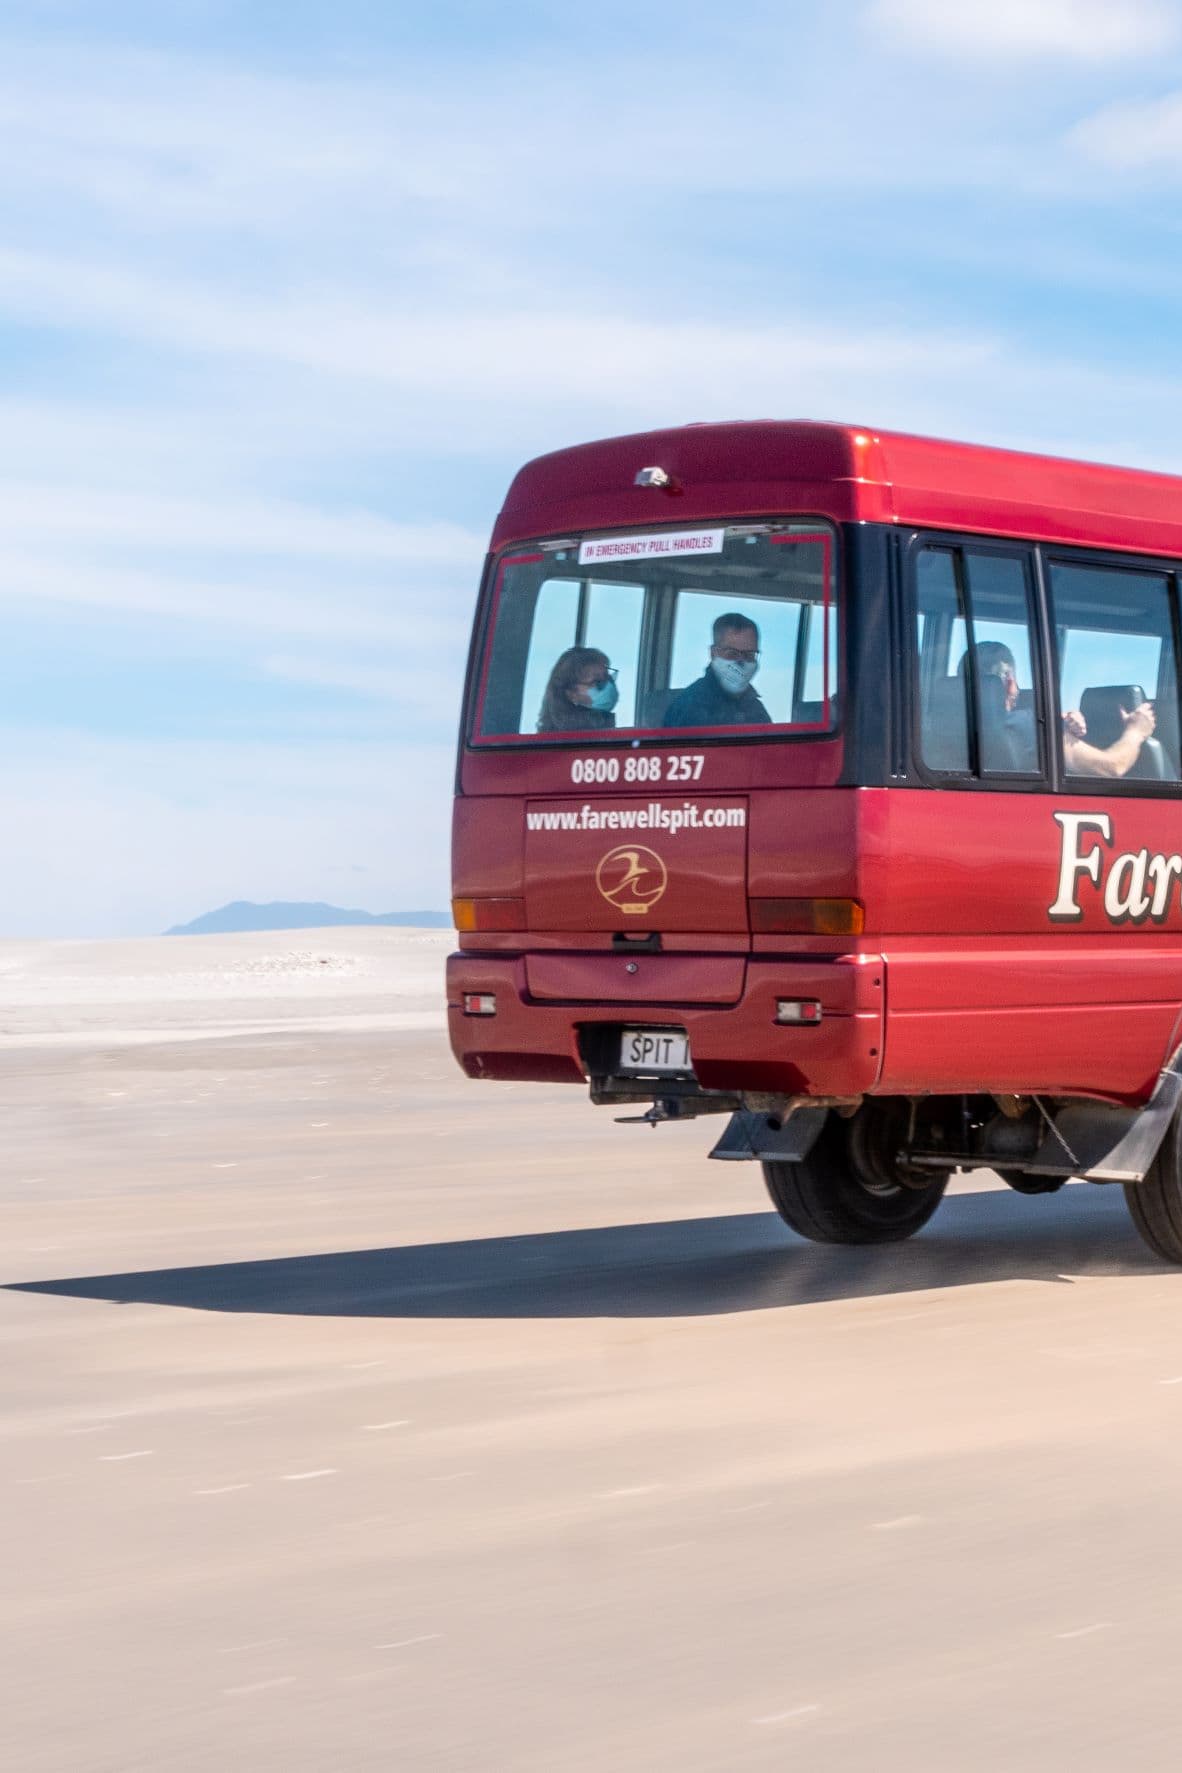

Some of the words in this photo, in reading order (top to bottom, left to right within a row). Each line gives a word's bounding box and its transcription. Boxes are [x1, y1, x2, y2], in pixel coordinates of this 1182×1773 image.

[596, 542, 648, 557] EMERGENCY
[649, 540, 670, 553] PULL
[672, 536, 713, 550] HANDLES
[571, 758, 620, 783] 0800
[624, 757, 662, 781] 808
[666, 755, 705, 781] 257
[526, 803, 746, 834] www.farewellspit.com
[630, 1037, 674, 1064] SPIT
